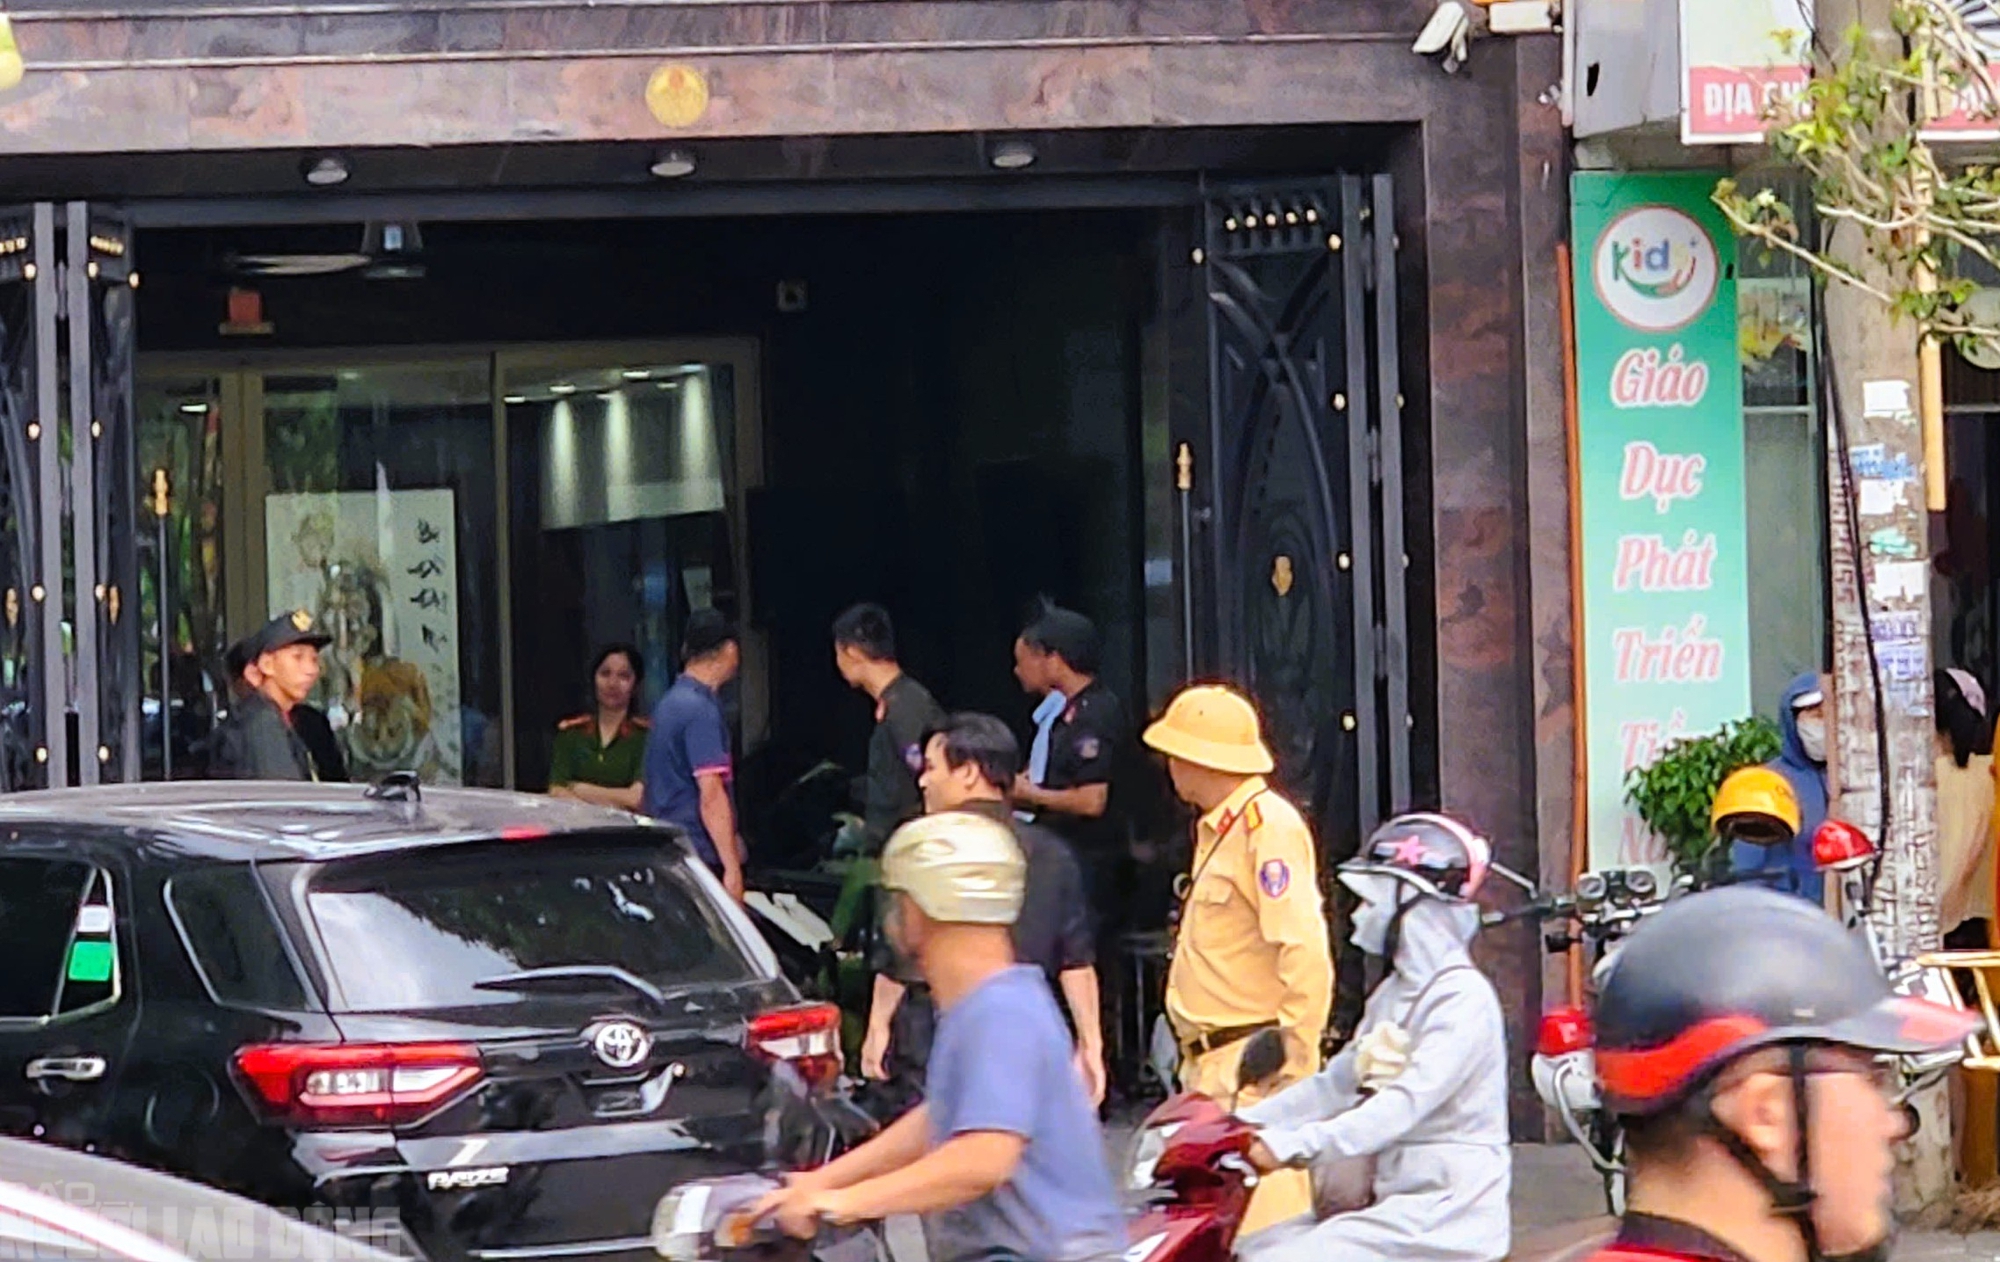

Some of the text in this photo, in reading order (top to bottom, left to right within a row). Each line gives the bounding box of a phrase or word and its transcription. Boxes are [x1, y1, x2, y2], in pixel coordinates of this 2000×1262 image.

[1612, 345, 1708, 405] Giáo
[1621, 442, 1705, 511] Dục
[1616, 531, 1715, 590] Phát
